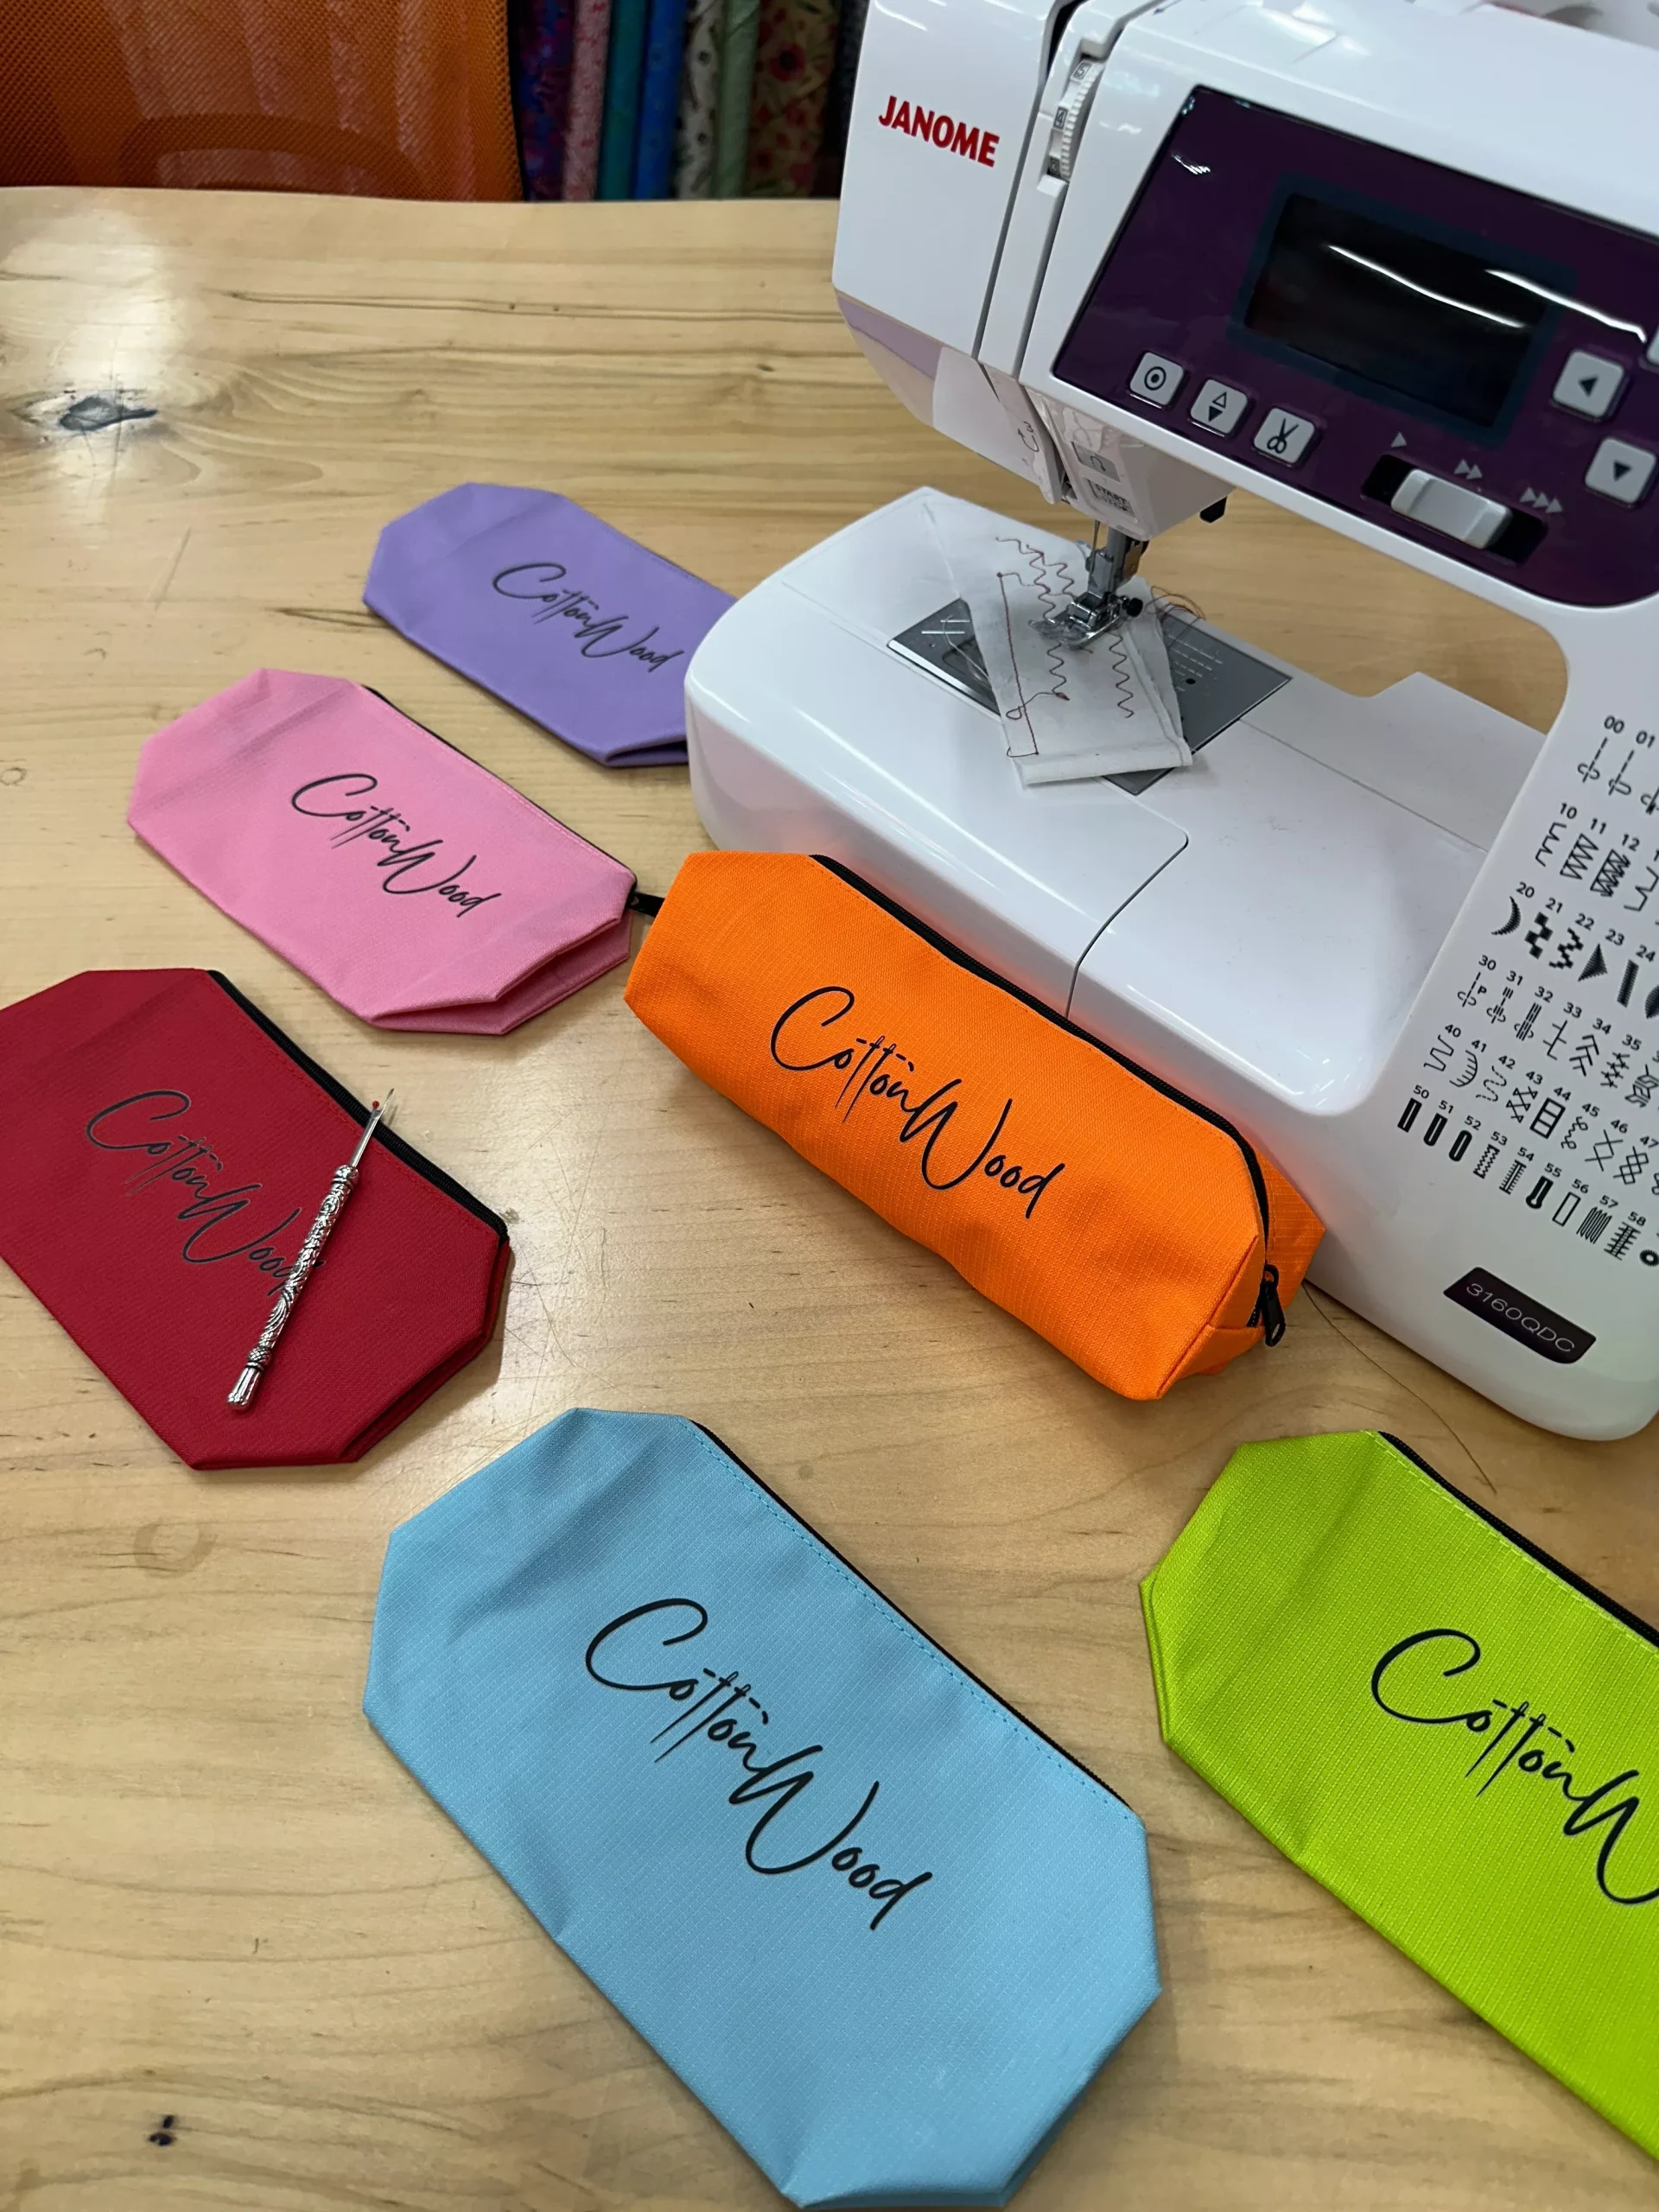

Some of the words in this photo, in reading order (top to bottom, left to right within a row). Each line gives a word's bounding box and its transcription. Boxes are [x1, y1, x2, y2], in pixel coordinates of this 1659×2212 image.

[879, 95, 1000, 168] JANOME
[1095, 483, 1127, 505] START
[1604, 715, 1624, 734] 00
[1636, 731, 1656, 748] 01
[1560, 803, 1577, 819] 10
[1591, 818, 1607, 835] 11
[1622, 833, 1640, 852] 12
[1516, 881, 1535, 898] 20
[1545, 897, 1563, 913] 21
[1574, 912, 1595, 931] 22
[1605, 929, 1624, 946] 23
[1636, 944, 1656, 963] 24
[1477, 985, 1487, 995] P
[1478, 955, 1497, 970] 30
[1506, 970, 1523, 986] 31
[1535, 986, 1554, 1002] 32
[1563, 1002, 1582, 1018] 33
[1592, 1018, 1611, 1035] 34
[1622, 1034, 1642, 1051] 35
[1445, 1024, 1461, 1038] 40
[1471, 1039, 1487, 1052] 41
[1498, 1055, 1516, 1070] 42
[1526, 1071, 1543, 1085] 43
[1554, 1087, 1571, 1102] 44
[1582, 1103, 1600, 1117] 45
[1611, 1119, 1628, 1134] 46
[1640, 1135, 1659, 1149] 47
[1412, 1084, 1429, 1099] 50
[1439, 1100, 1454, 1114] 51
[1464, 1116, 1481, 1130] 52
[1491, 1131, 1508, 1146] 53
[1517, 1147, 1535, 1161] 54
[1544, 1162, 1562, 1178] 55
[1572, 1179, 1589, 1193] 56
[1599, 1195, 1618, 1208] 57
[1628, 1211, 1646, 1226] 58
[1466, 1283, 1575, 1352] 3160QDC
